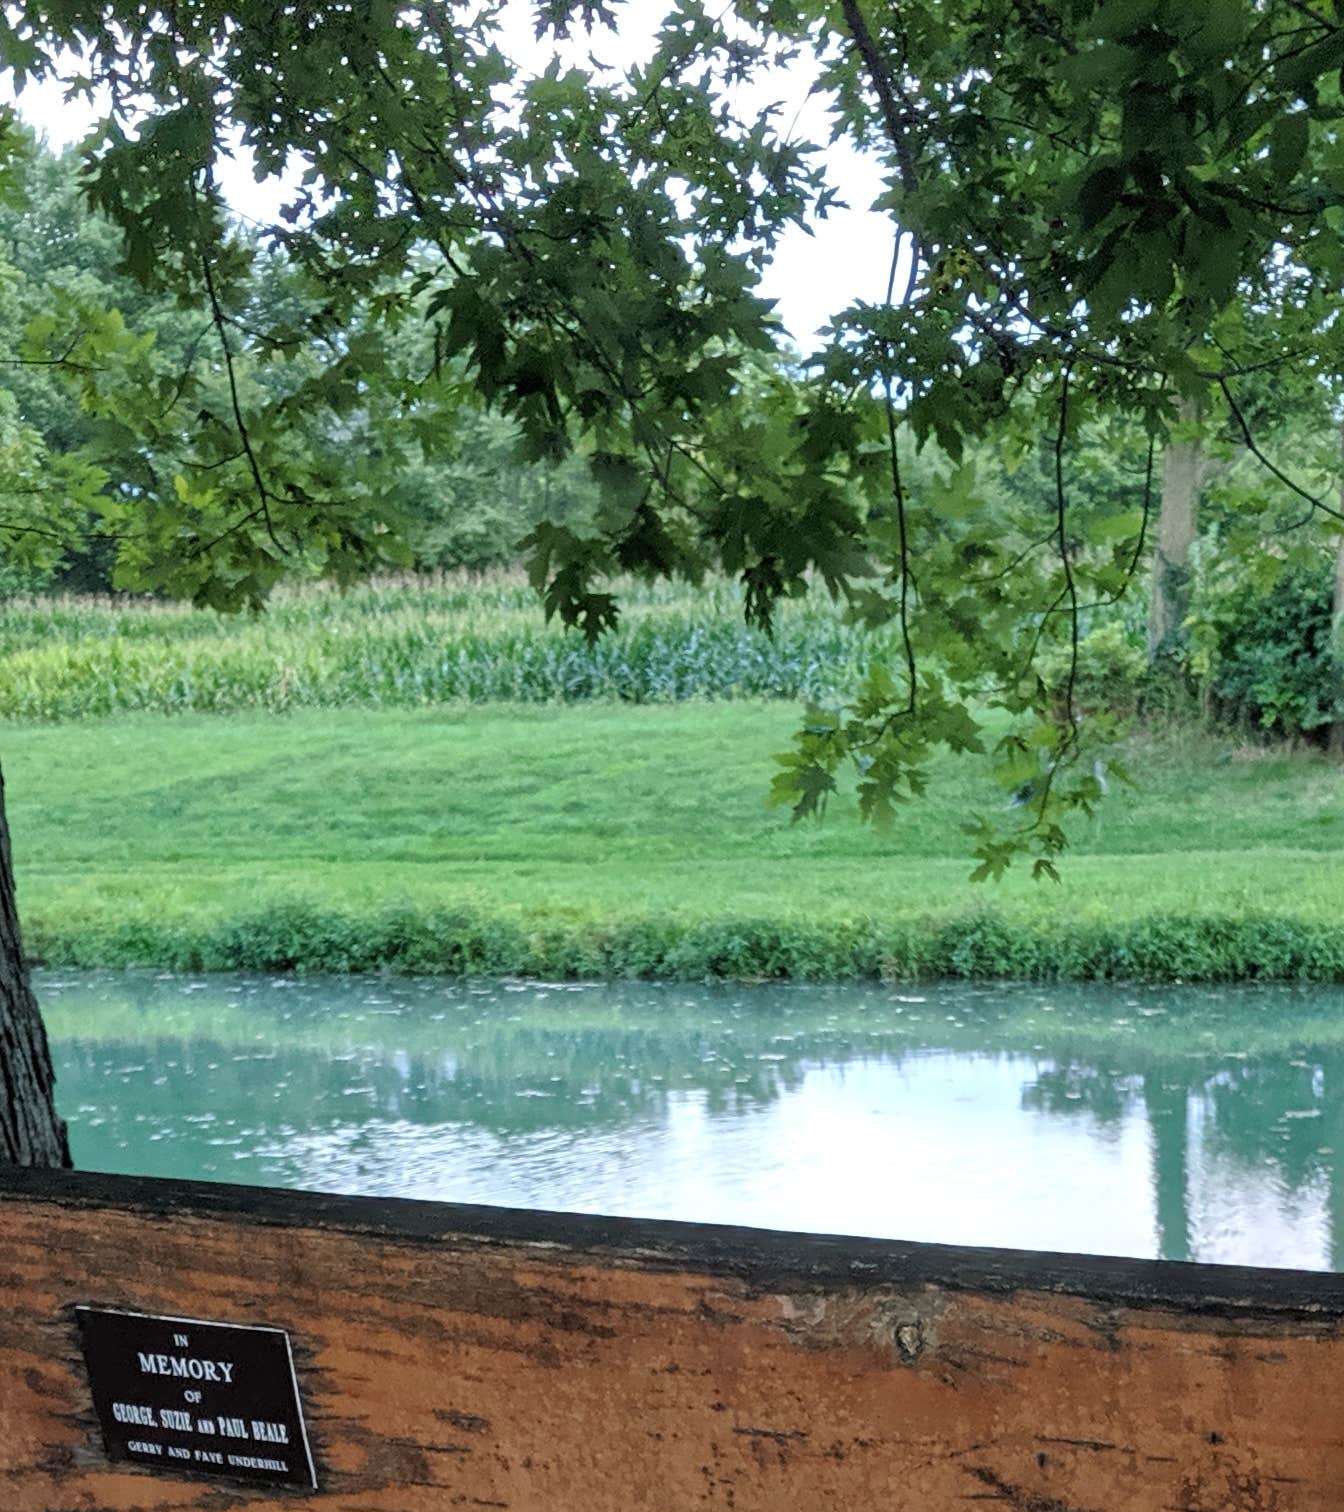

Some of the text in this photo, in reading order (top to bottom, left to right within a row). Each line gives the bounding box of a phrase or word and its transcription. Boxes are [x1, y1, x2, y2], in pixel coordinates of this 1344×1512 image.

[173, 1334, 189, 1347] IN
[137, 1352, 234, 1383] MEMORY
[183, 1390, 202, 1404] OF
[159, 1408, 193, 1432] SUZIE
[197, 1419, 216, 1435] AND
[216, 1416, 249, 1439] PAUL
[251, 1420, 289, 1444] BEALE
[167, 1446, 191, 1459] AND
[194, 1450, 224, 1465] FAYE
[227, 1454, 289, 1473] UNDERHILL
